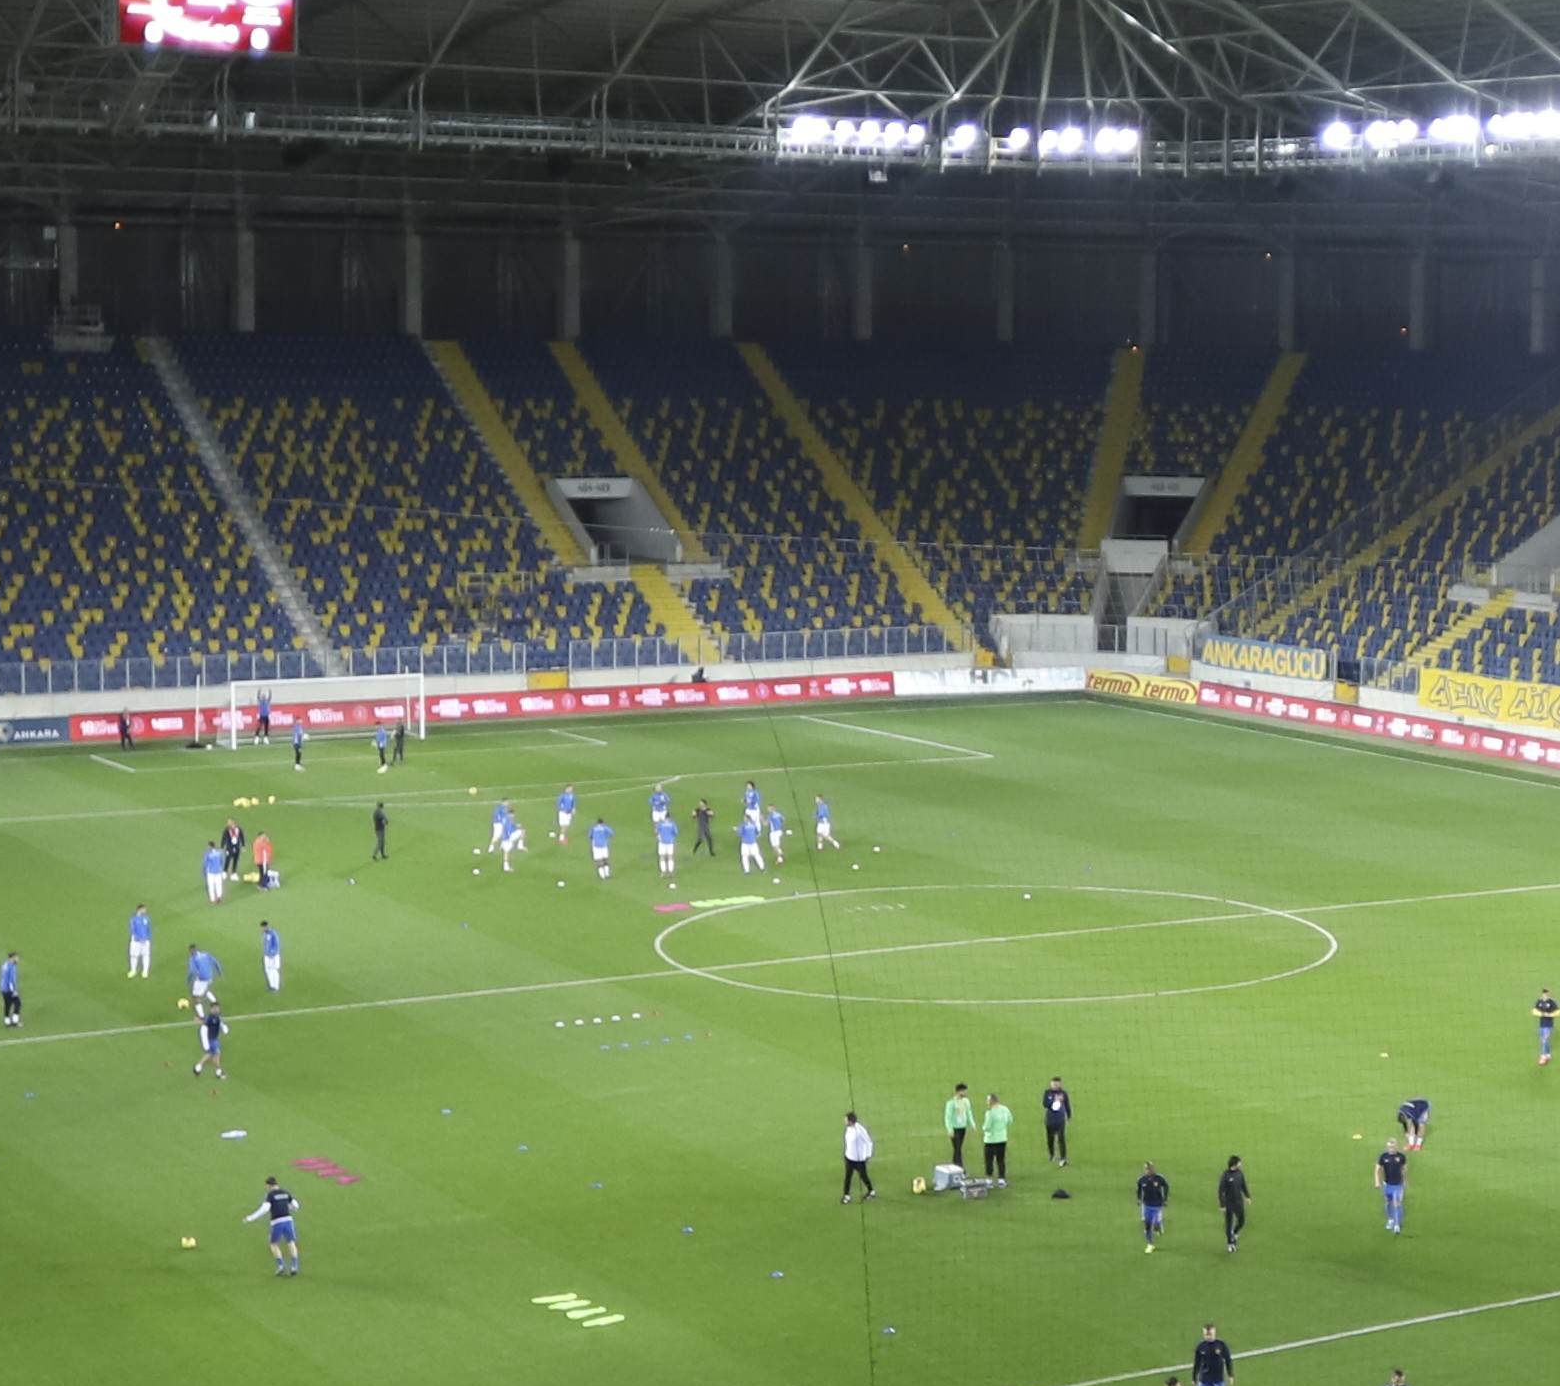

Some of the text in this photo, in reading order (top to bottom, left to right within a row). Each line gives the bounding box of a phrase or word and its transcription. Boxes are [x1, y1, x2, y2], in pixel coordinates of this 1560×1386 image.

[1089, 673, 1132, 693] termo
[1143, 681, 1189, 702] termo
[14, 728, 60, 740] ANKARA
